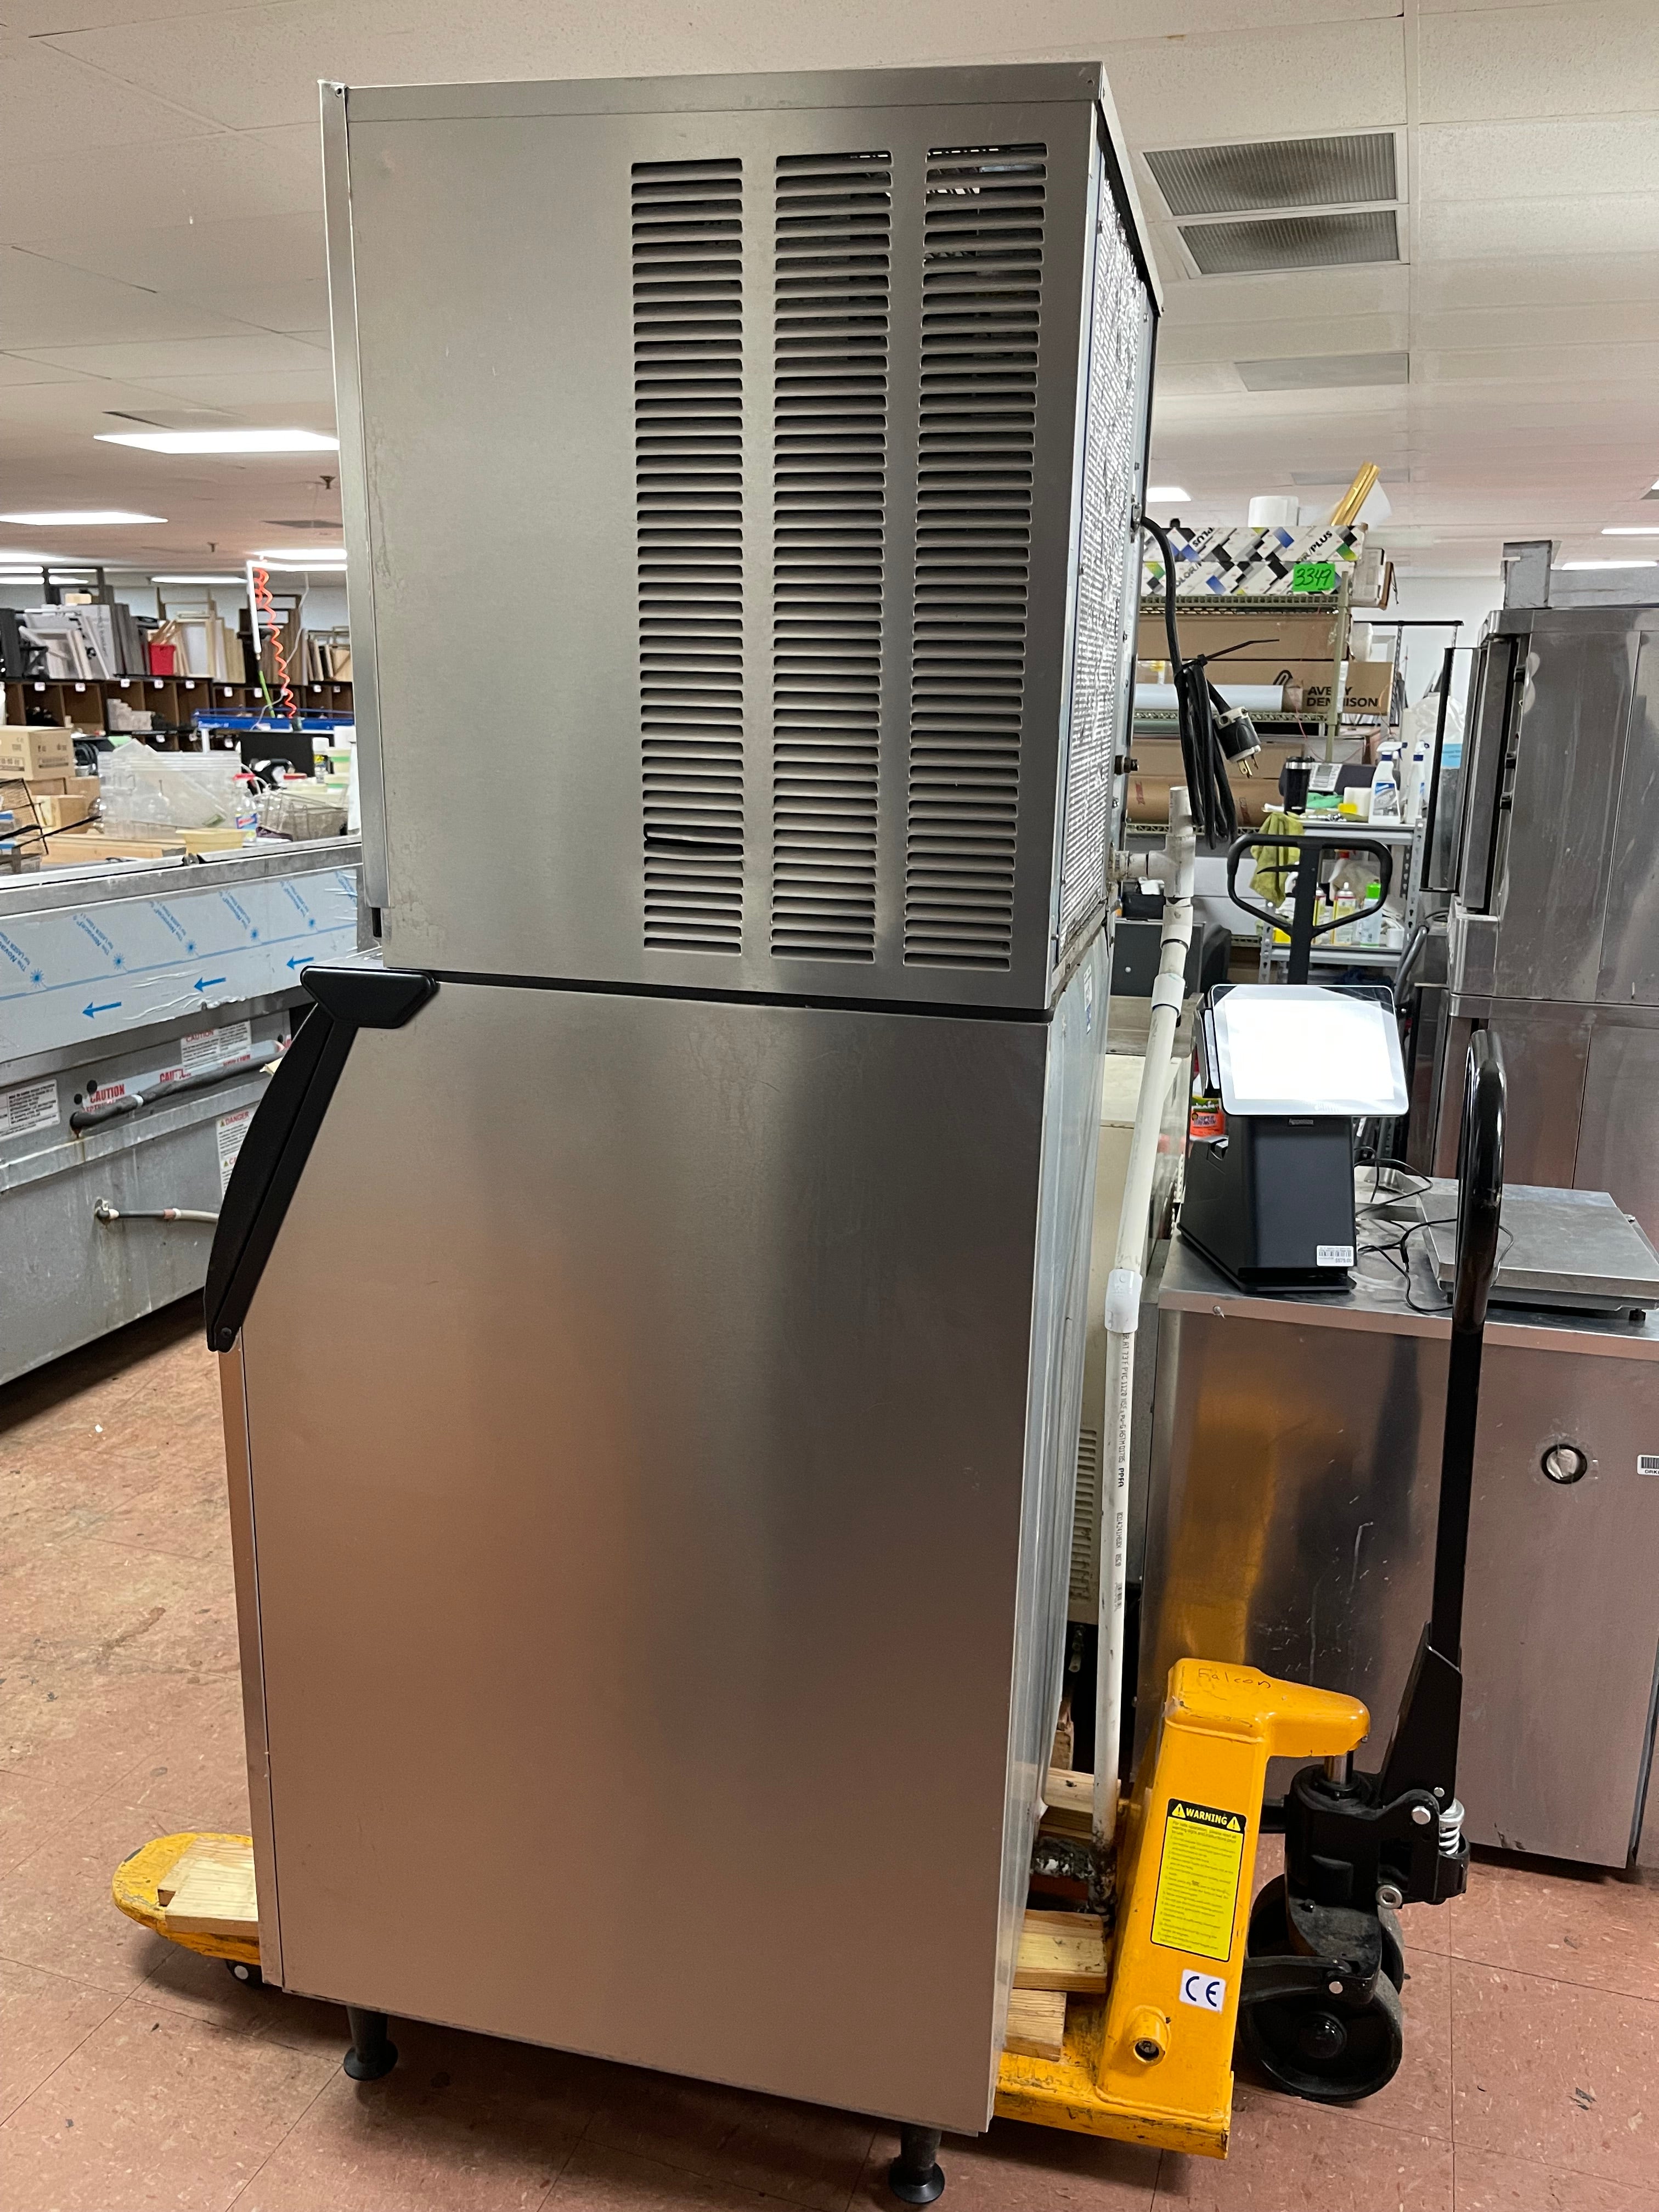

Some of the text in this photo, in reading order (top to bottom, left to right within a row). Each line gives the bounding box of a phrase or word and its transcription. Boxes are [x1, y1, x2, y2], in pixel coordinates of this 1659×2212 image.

[1295, 567, 1332, 587] 3349
[1307, 686, 1353, 696] AVEY
[1307, 697, 1379, 707] DENISON
[0, 941, 18, 962] Nova
[185, 1029, 214, 1042] CAUTION
[225, 1111, 250, 1125] DANGER
[1198, 1668, 1271, 1689] Falcon
[1186, 1808, 1227, 1825] WARNING
[1185, 1976, 1220, 2007] CE
